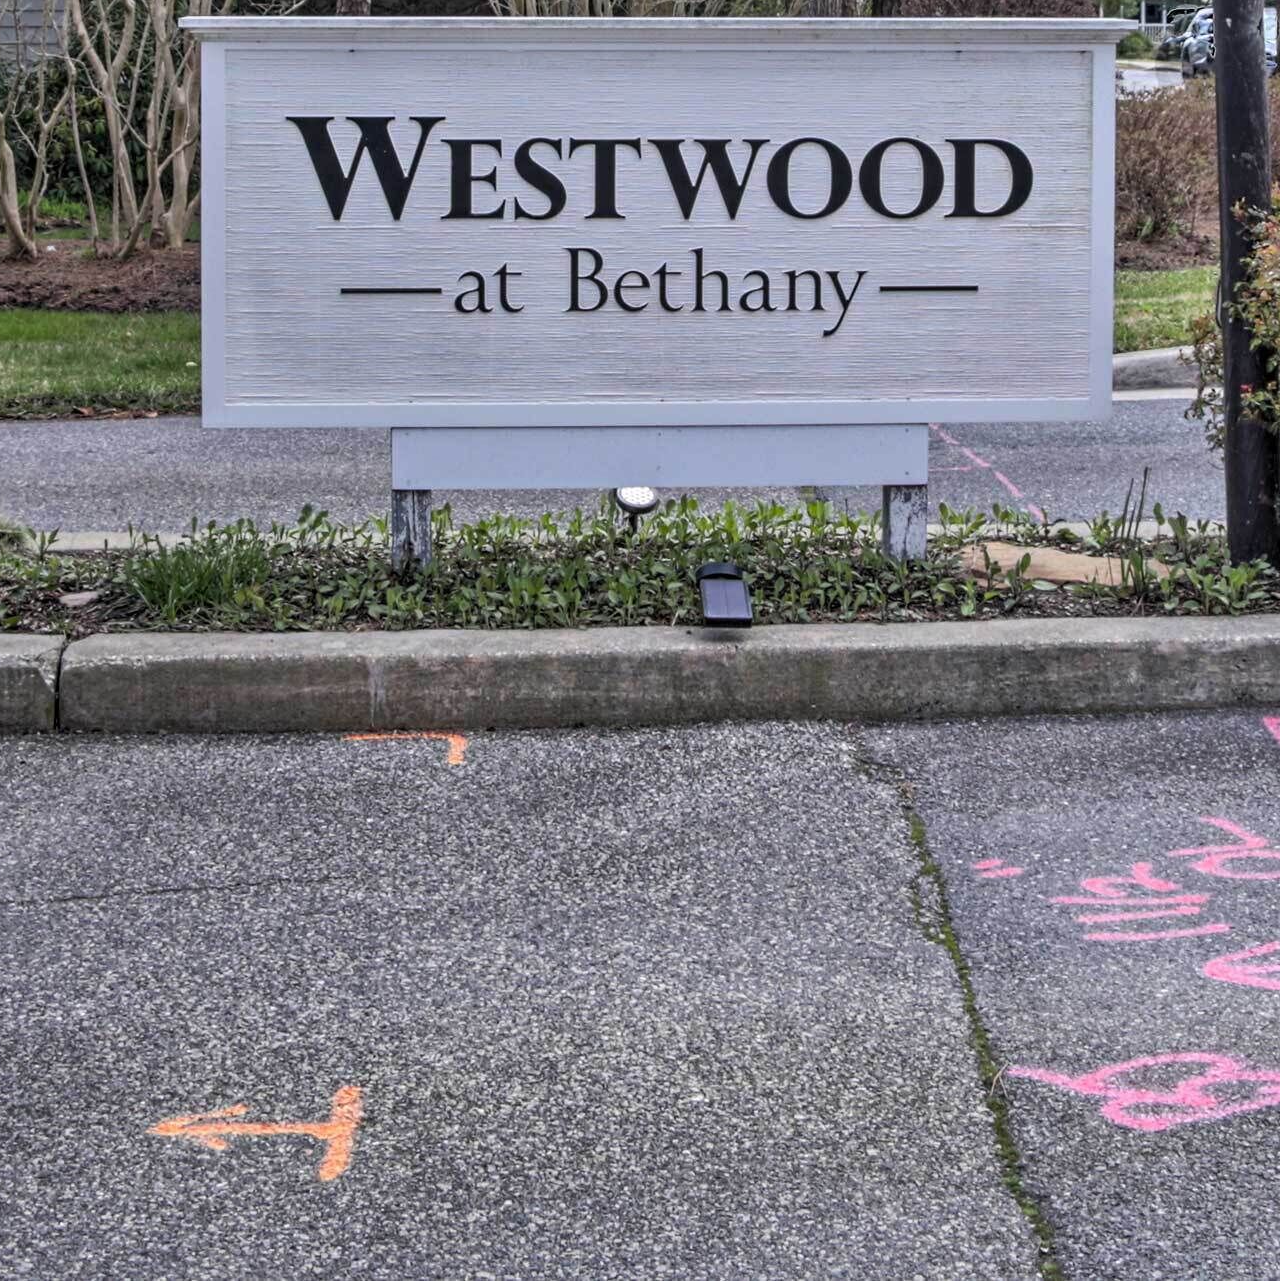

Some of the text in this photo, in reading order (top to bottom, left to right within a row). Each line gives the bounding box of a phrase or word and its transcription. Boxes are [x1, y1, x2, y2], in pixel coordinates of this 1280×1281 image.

[284, 115, 1034, 221] WESTWOOD
[453, 246, 868, 338] at Bethany
